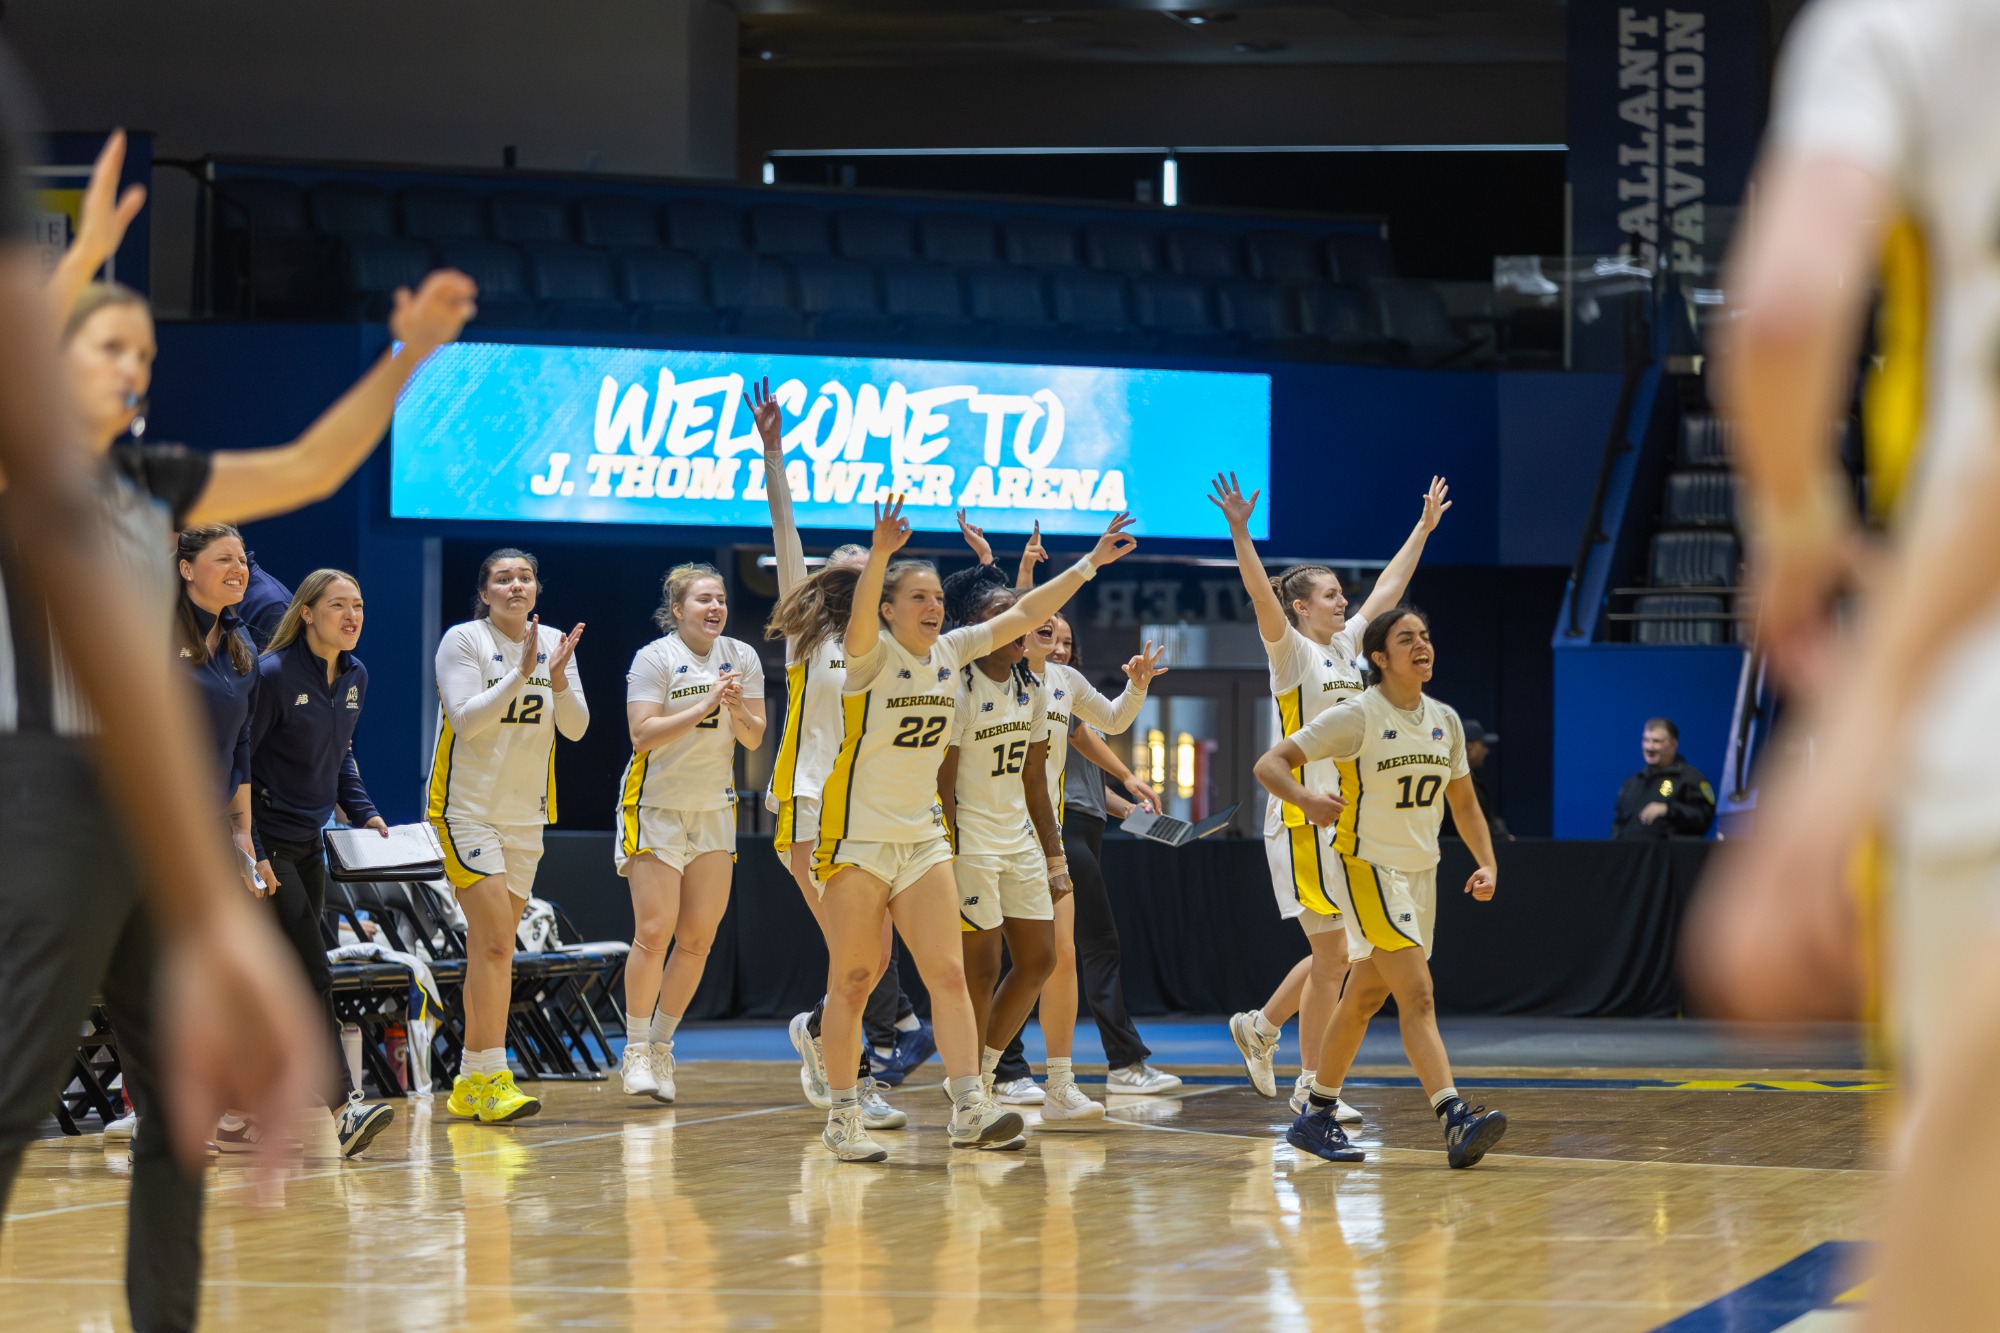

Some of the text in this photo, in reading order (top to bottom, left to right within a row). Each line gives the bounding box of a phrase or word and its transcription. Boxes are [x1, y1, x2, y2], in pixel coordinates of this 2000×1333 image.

[1664, 8, 1705, 275] PAVILION
[594, 366, 1065, 470] WELCOME TO
[530, 452, 575, 496] J.
[586, 454, 741, 500] THOM
[957, 465, 1128, 511] ARENA
[671, 684, 713, 699] MERRI
[500, 694, 544, 724] 12
[892, 716, 948, 748] 22
[975, 721, 1032, 741] MERRIMAC
[991, 740, 1026, 777] 15
[1395, 775, 1442, 809] 10
